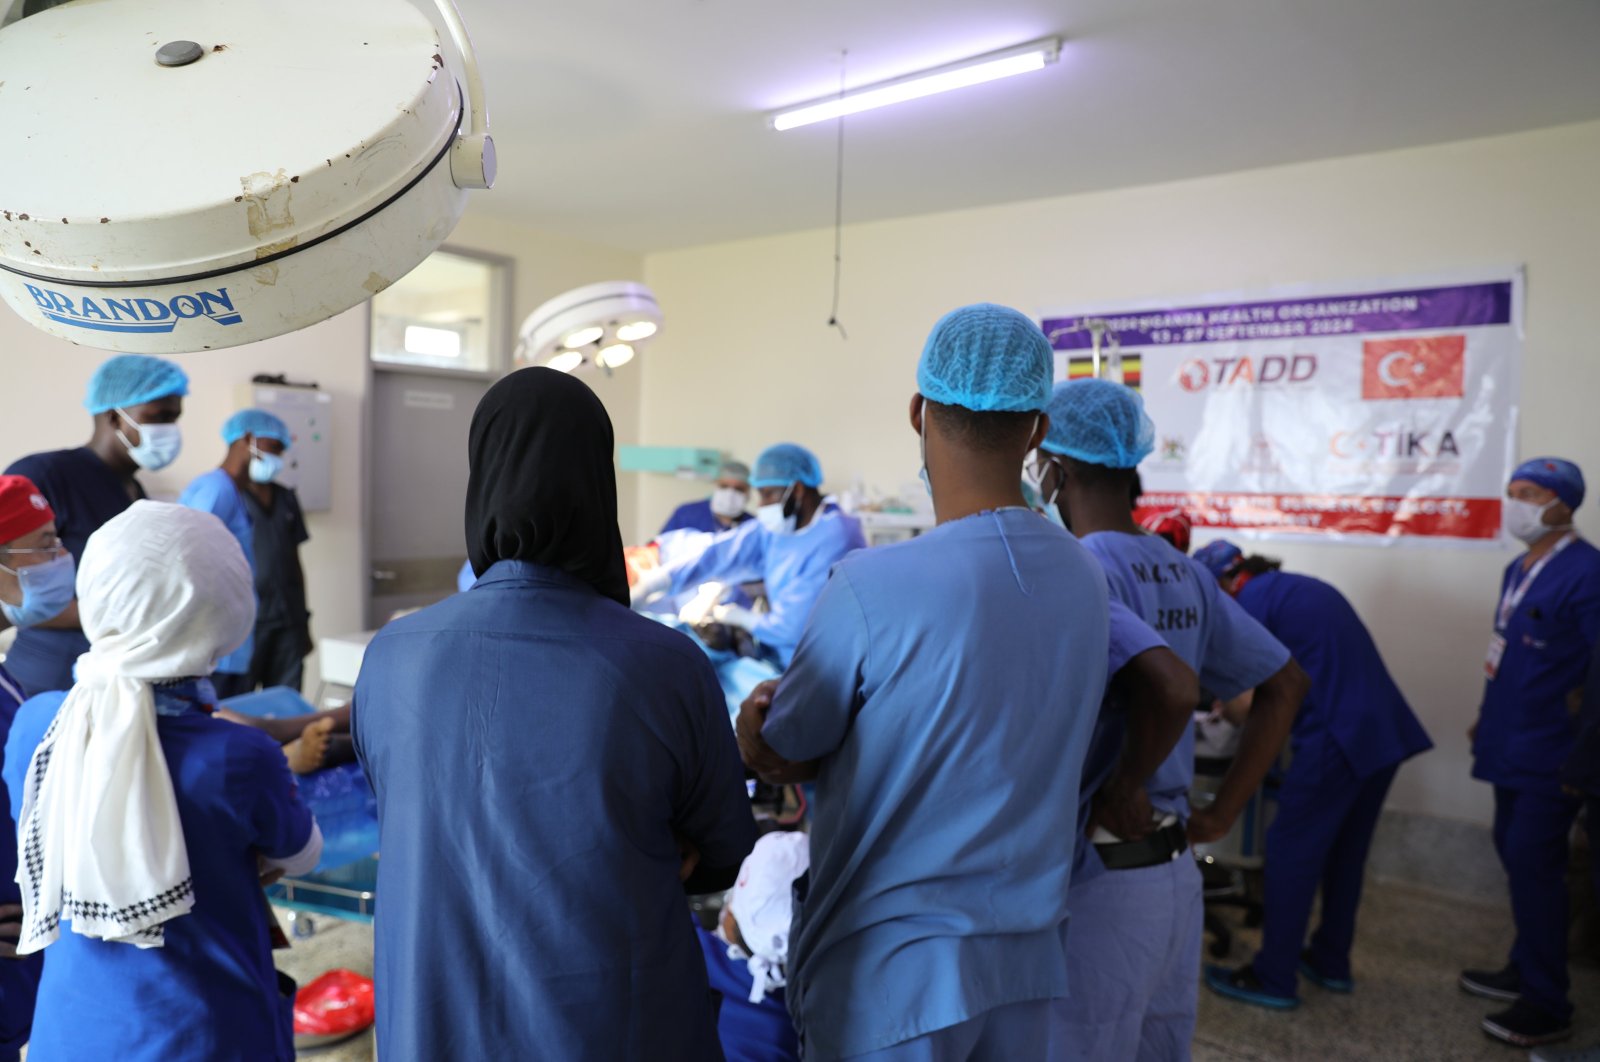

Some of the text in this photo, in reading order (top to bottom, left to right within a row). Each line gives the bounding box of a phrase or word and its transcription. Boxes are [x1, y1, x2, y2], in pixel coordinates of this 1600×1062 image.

[23, 283, 236, 321] BRANDON
[1208, 306, 1275, 325] HEALTH
[1278, 296, 1418, 320] ORGANIZATION
[1206, 320, 1306, 341] SEPTEMBER
[1214, 354, 1317, 385] TADD
